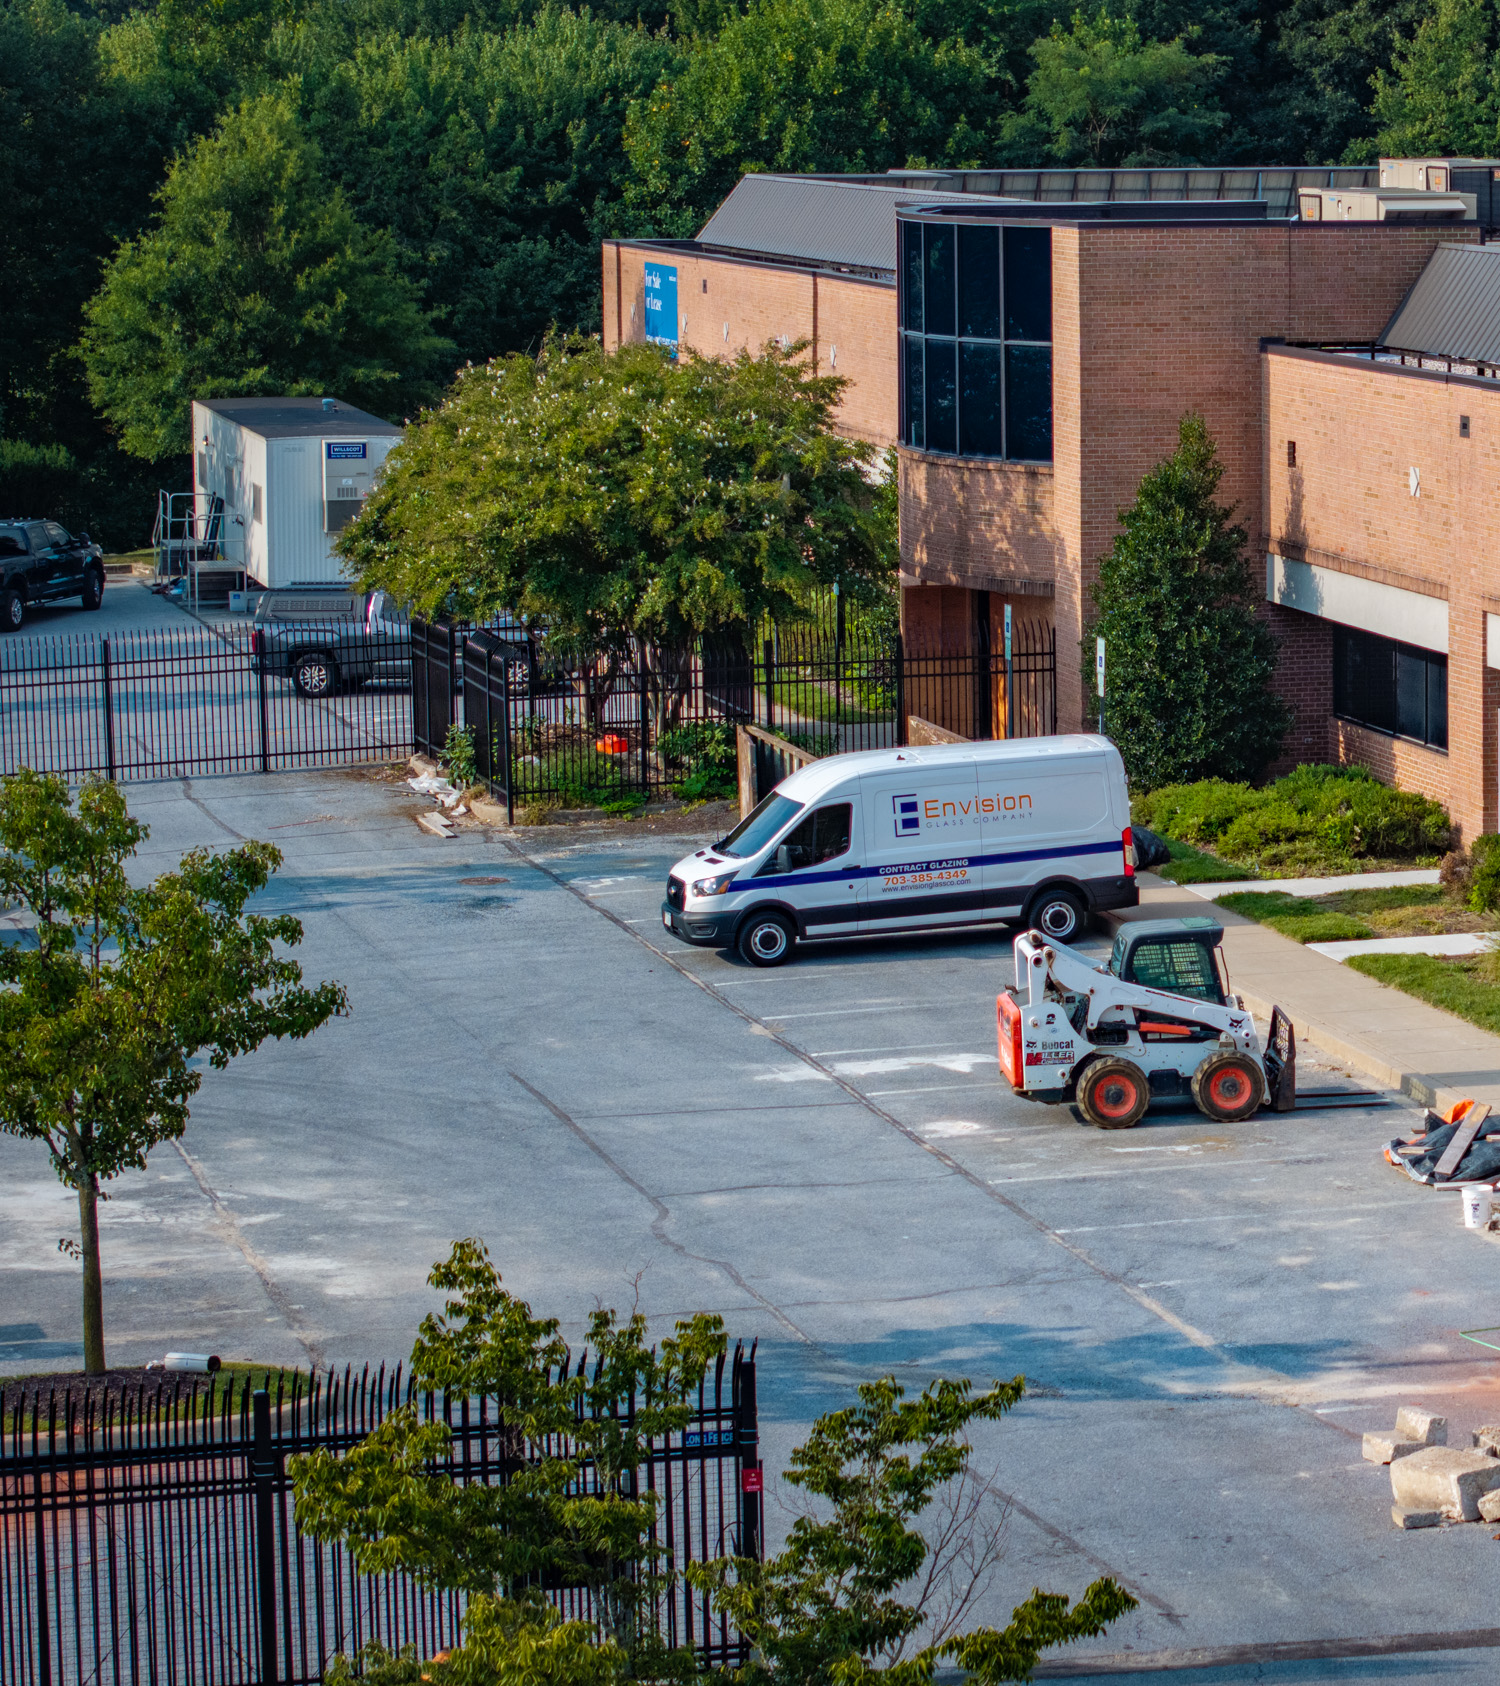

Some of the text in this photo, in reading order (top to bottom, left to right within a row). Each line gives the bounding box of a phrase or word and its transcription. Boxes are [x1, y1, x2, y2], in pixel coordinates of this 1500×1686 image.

[924, 793, 1032, 818] Envision
[926, 812, 1033, 829] GLASS COMPANY
[879, 859, 969, 875] CONTRACT GLAZING
[882, 878, 971, 893] www.envisionglassco.com
[883, 869, 967, 886] 703-385-4349
